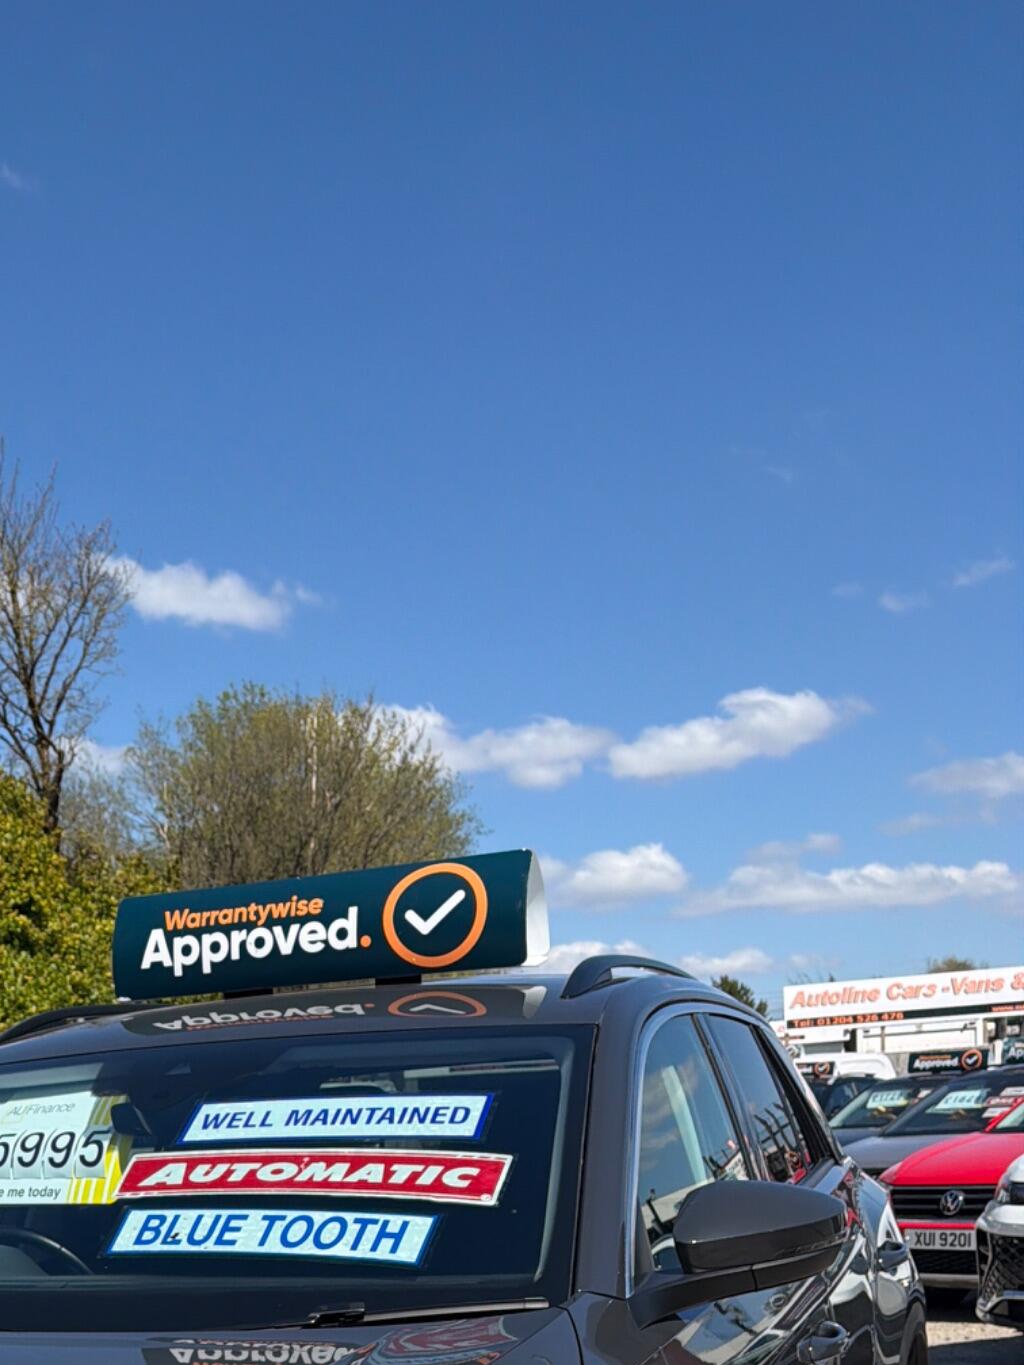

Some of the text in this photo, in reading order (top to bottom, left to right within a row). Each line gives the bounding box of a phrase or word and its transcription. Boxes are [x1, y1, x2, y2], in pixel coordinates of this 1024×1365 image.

[164, 895, 324, 932] Warrantywise
[140, 906, 372, 977] Approved.
[790, 986, 881, 1009] Autoline
[886, 981, 937, 1000] Cars
[792, 1019, 814, 1029] Tel:
[201, 1106, 471, 1131] WELL MAINTAINED
[136, 1162, 481, 1188] AUTOMATIC
[7, 1189, 25, 1198] me
[28, 1186, 61, 1200] today
[133, 1213, 409, 1255] BLUE TOOTH
[914, 1232, 972, 1248] XUI 9201
